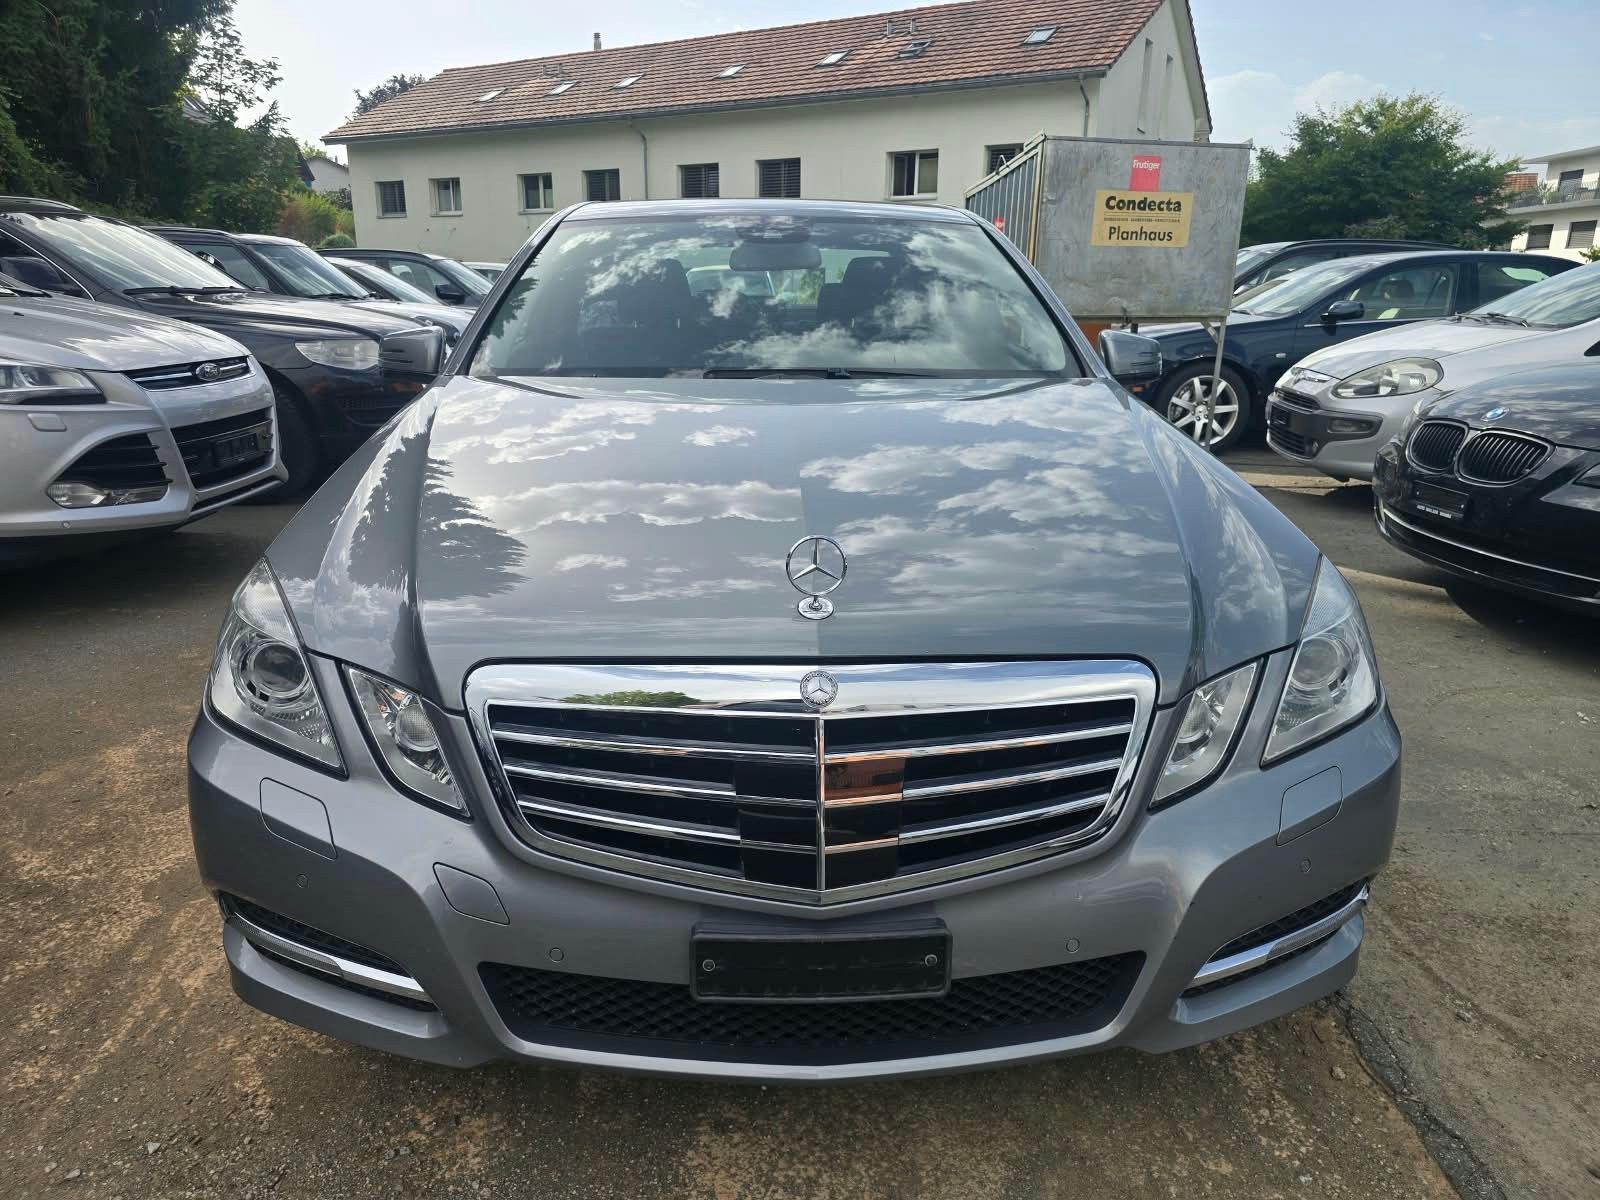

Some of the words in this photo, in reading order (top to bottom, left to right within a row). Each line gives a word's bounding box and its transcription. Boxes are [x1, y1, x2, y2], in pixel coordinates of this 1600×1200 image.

[1133, 160, 1160, 170] Frutiger
[1105, 196, 1182, 212] Condecta
[1109, 226, 1173, 241] Planhaus
